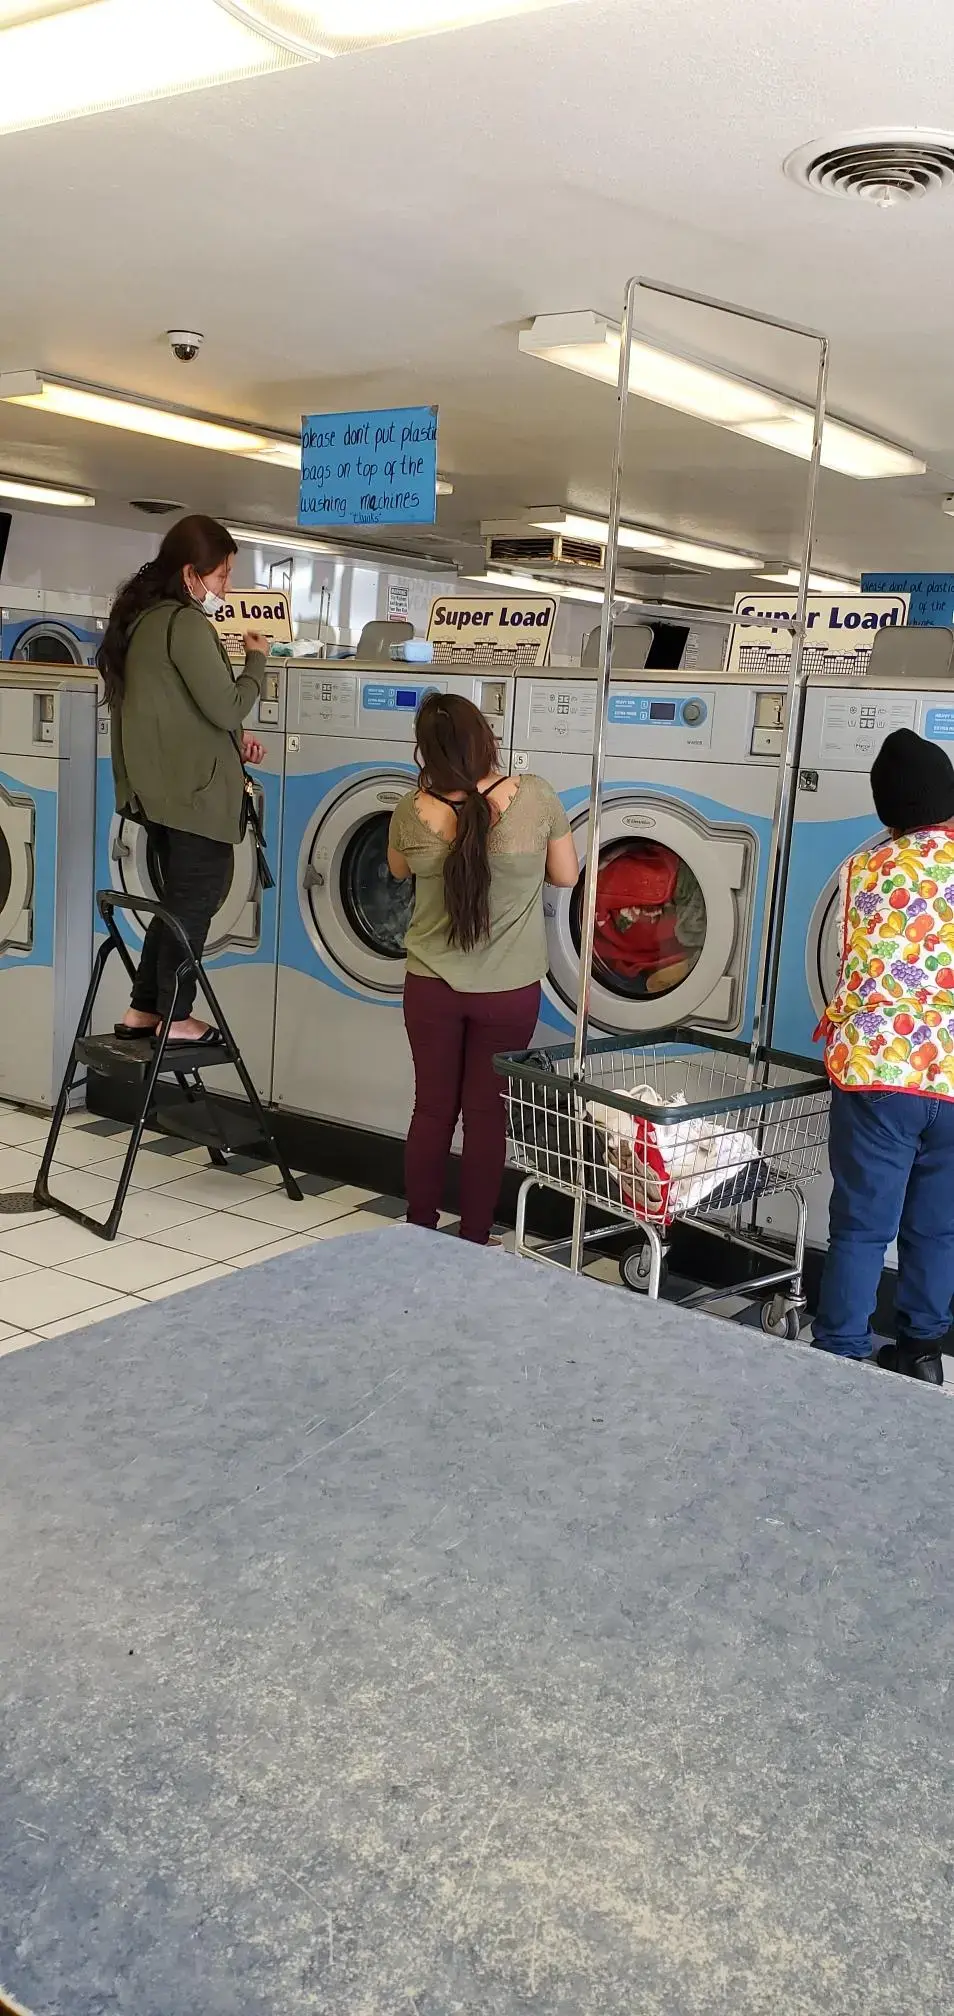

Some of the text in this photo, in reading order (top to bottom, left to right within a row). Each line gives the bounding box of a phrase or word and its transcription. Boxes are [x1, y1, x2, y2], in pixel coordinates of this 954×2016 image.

[344, 422, 370, 446] don't
[375, 421, 395, 453] put
[302, 455, 424, 488] bags on top of the
[300, 491, 419, 517] washing machines
[205, 600, 286, 622] ga Load
[434, 606, 551, 630] Super Load
[740, 606, 899, 634] Spr Load
[518, 755, 523, 765] 5
